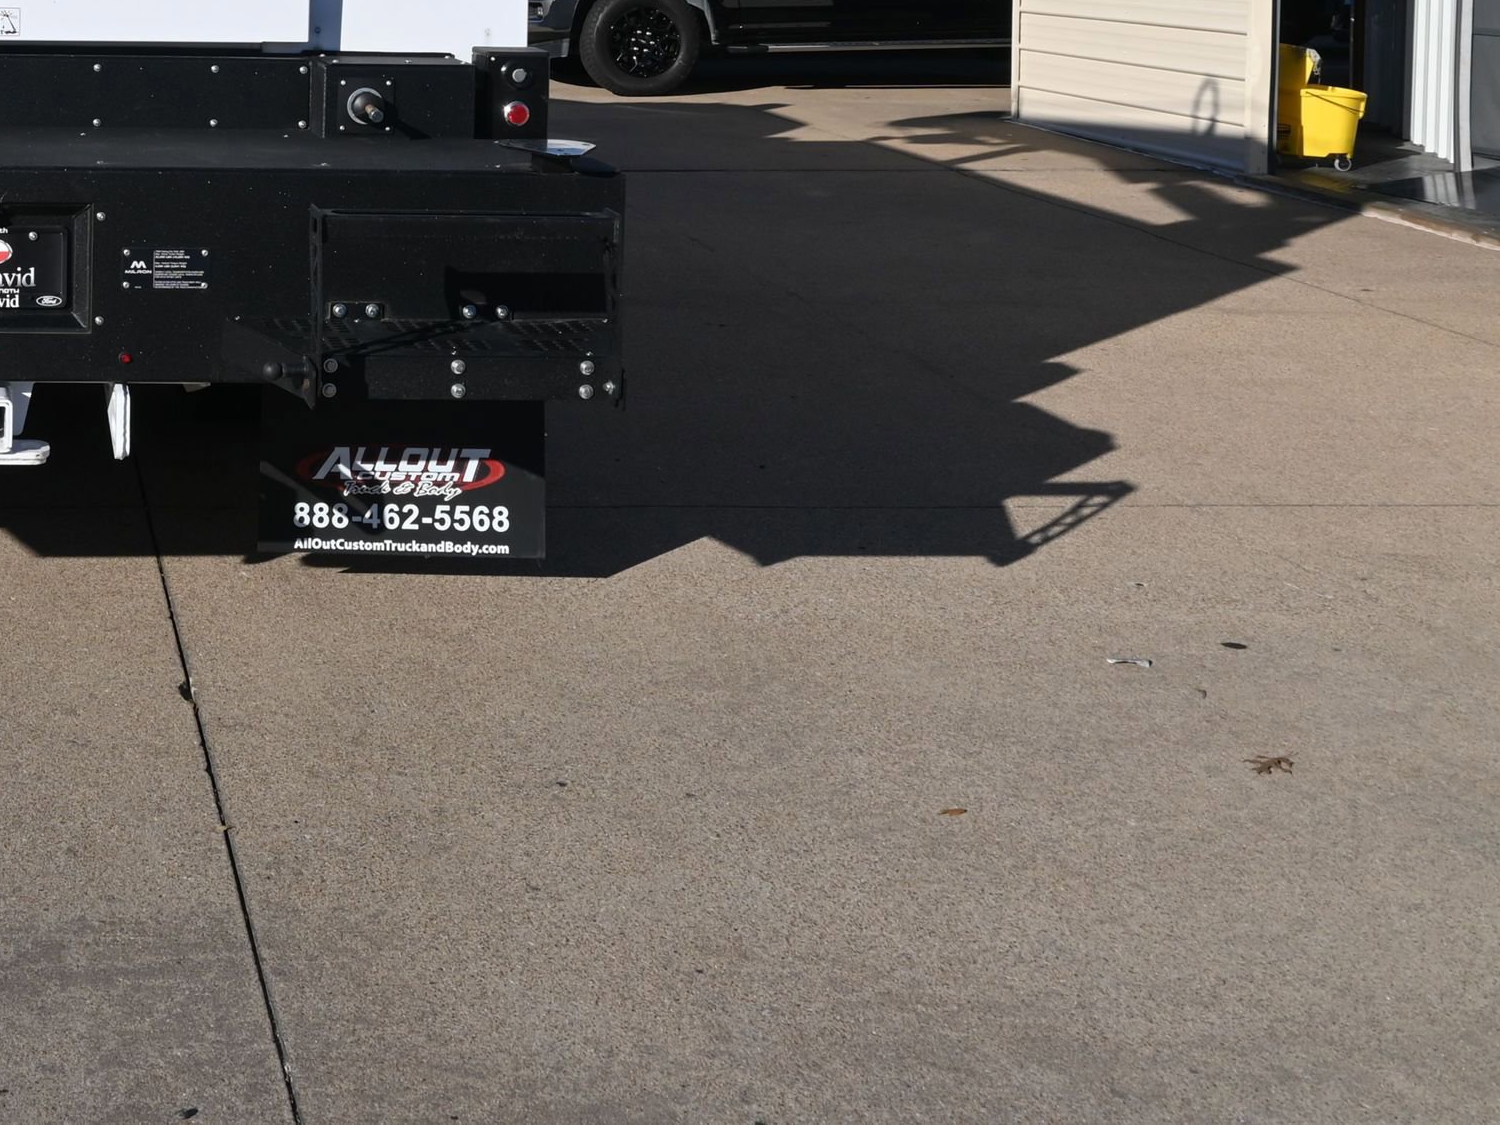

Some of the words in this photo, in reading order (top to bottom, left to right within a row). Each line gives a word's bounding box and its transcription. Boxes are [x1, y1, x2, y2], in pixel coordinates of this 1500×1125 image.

[312, 446, 492, 483] ALLOUT
[356, 471, 460, 482] CUSTOM
[393, 483, 414, 495] &
[413, 481, 463, 502] Body
[293, 502, 510, 532] 888-462-5568
[293, 538, 510, 556] AllOutCustomTruckandBody.com
